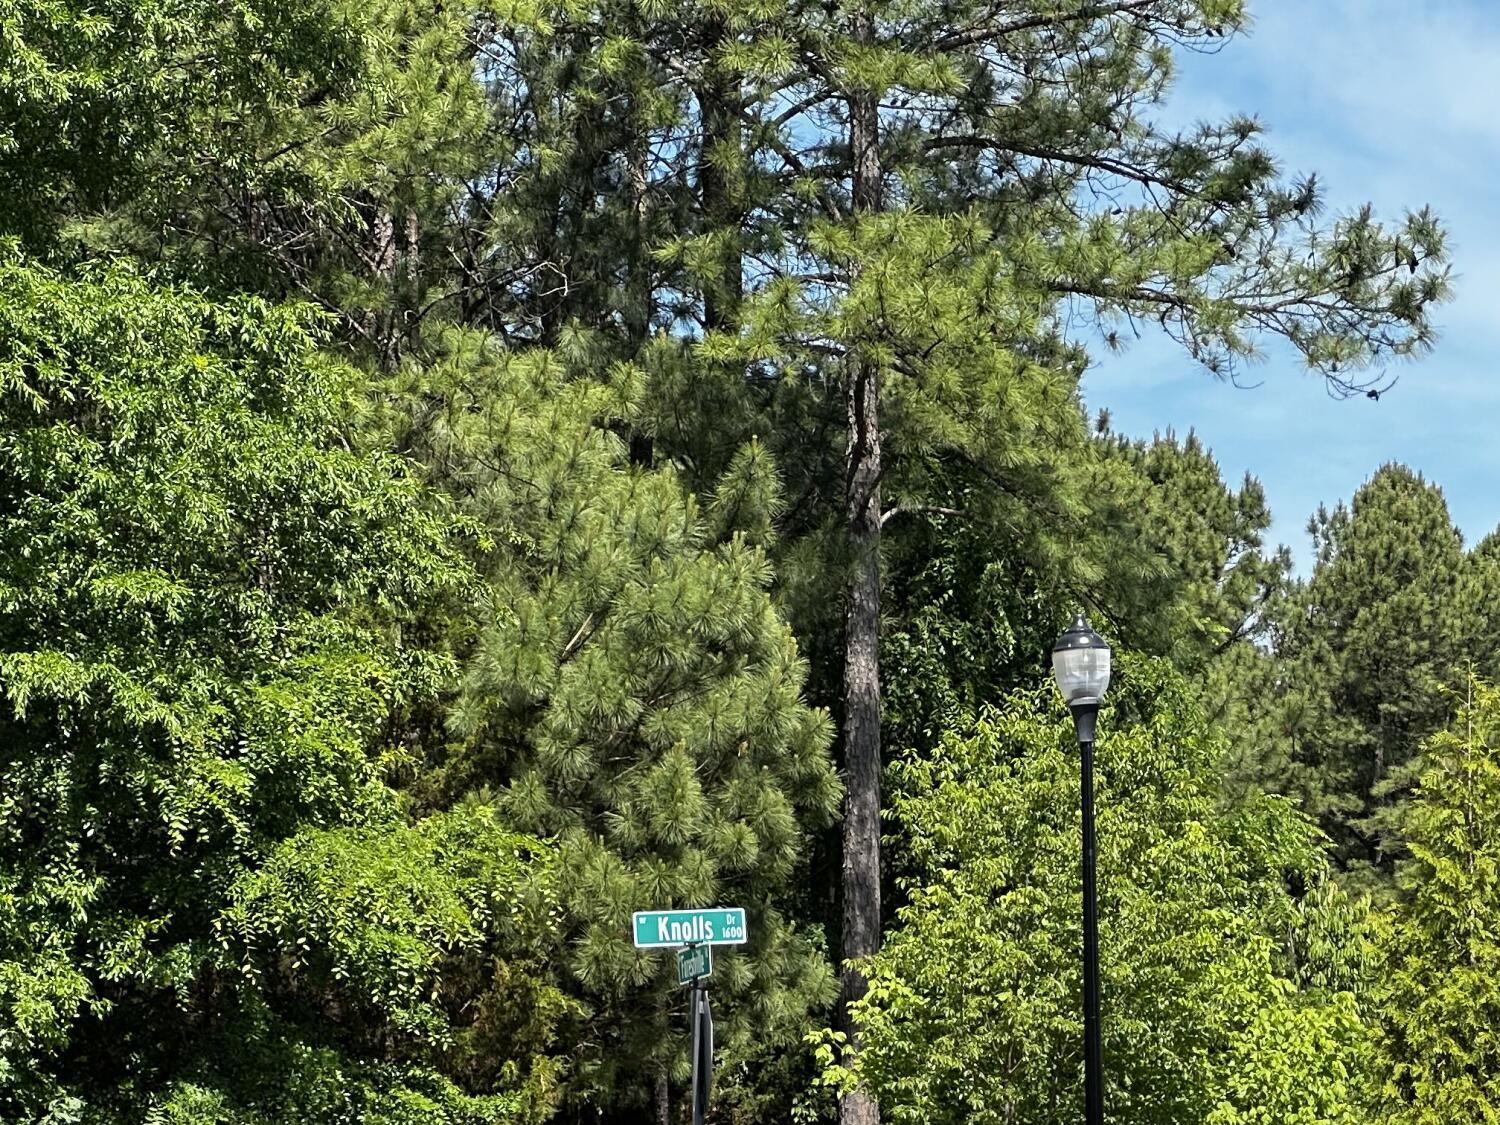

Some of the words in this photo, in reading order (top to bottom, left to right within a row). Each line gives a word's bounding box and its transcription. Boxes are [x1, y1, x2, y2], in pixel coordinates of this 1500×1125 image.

[657, 916, 714, 941] Knolls
[726, 914, 736, 925] Dr
[722, 926, 742, 938] 1600
